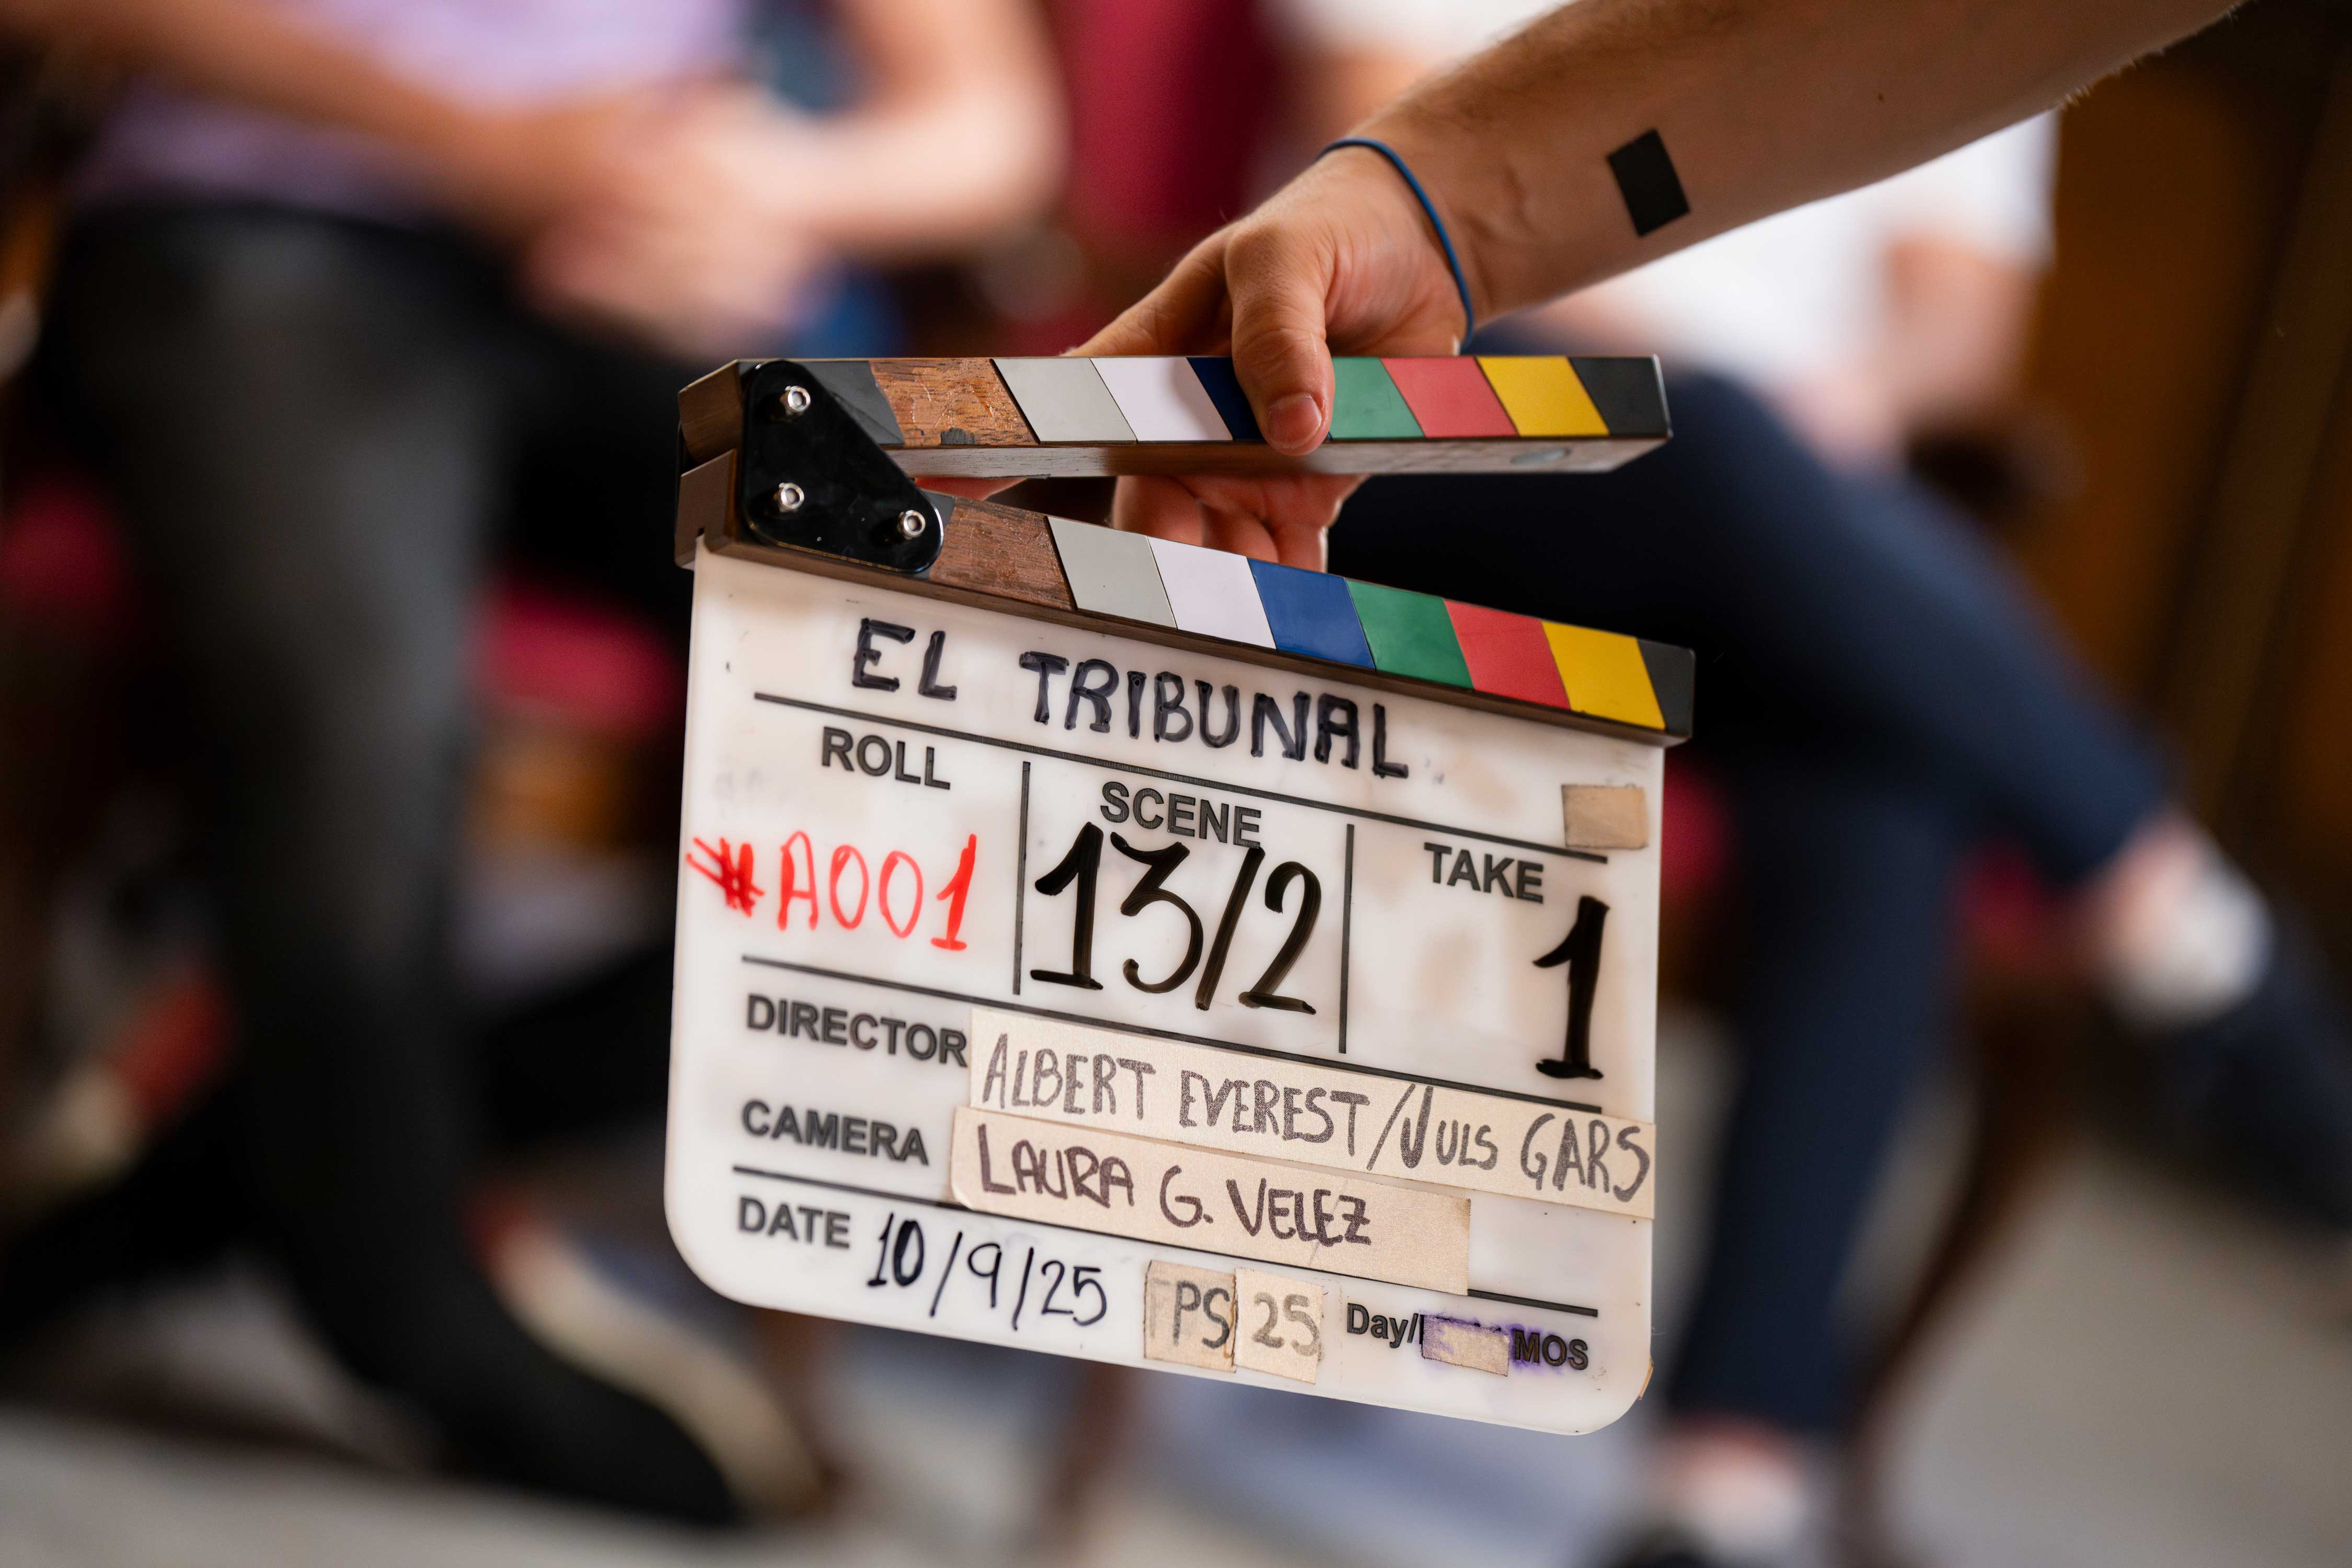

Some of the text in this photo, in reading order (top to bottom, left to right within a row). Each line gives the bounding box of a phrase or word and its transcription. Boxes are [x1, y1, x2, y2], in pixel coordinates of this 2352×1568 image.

[851, 618, 1409, 778] EL TRIBUNAL
[821, 726, 951, 790] ROLL
[1100, 781, 1262, 848] SCENE
[1424, 842, 1544, 904] TAKE
[1030, 821, 1322, 1016] 13/2
[1532, 895, 1610, 1080] 1
[747, 994, 968, 1068] DIRECTOR
[741, 1099, 929, 1166] CAMERA
[982, 1033, 1156, 1120] ALBERT
[1520, 1113, 1651, 1202] GARS
[737, 1196, 851, 1249] DATE
[977, 1123, 1372, 1246] LAURA G. VELEZ
[867, 1212, 1108, 1331] 10/9/25
[1173, 1279, 1230, 1348] PS
[1252, 1291, 1321, 1357] 25
[1515, 1328, 1589, 1370] MOS
